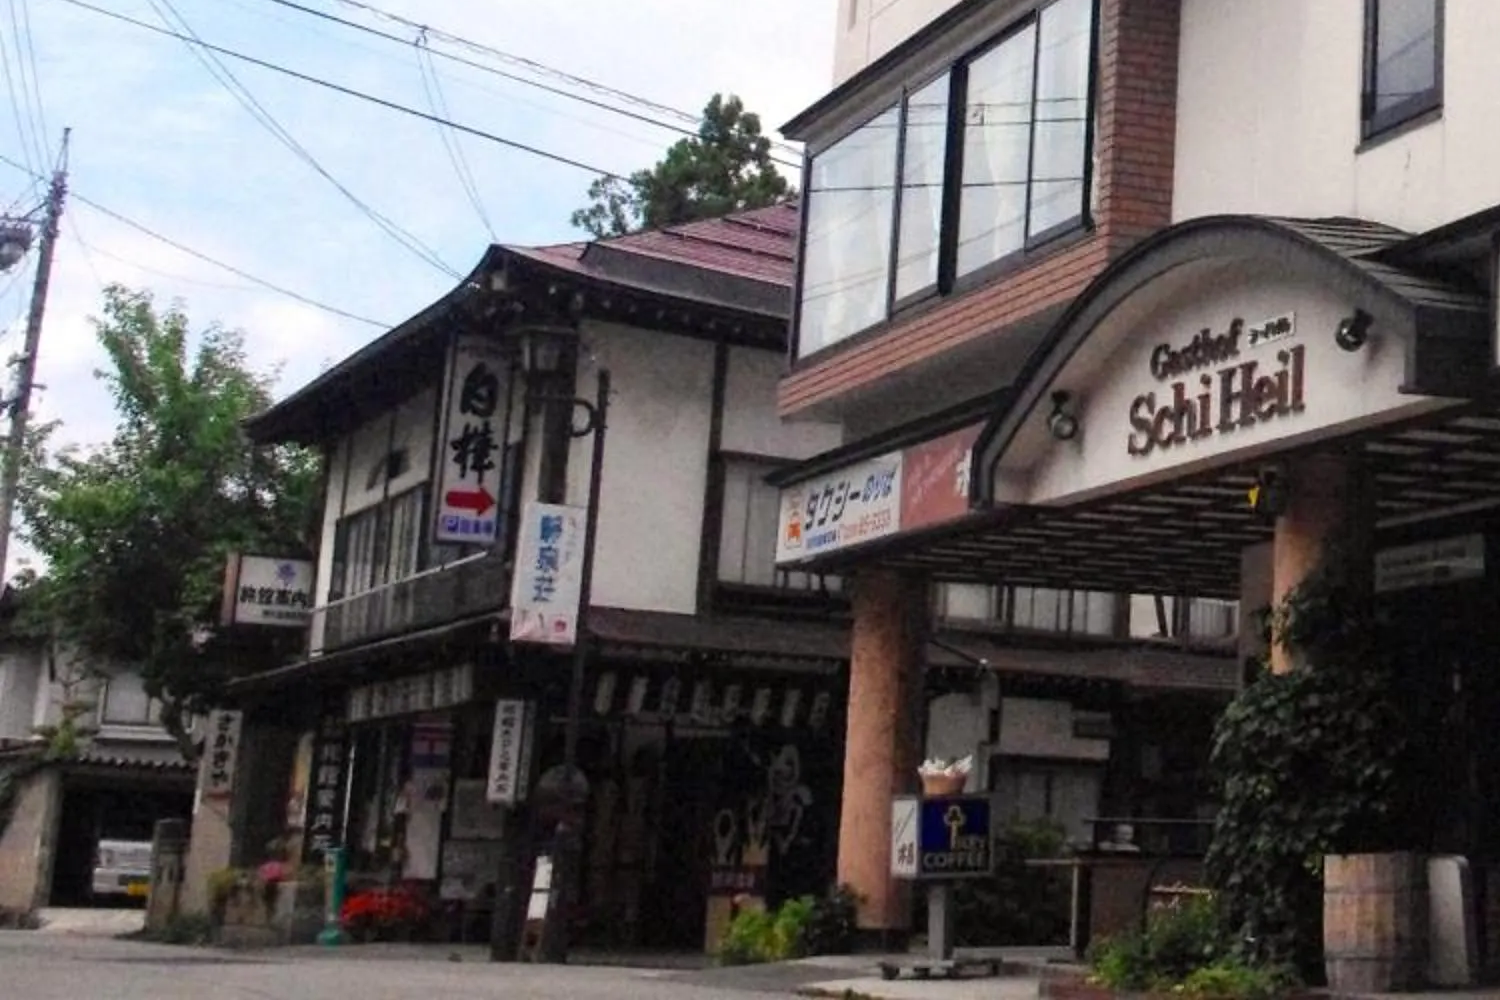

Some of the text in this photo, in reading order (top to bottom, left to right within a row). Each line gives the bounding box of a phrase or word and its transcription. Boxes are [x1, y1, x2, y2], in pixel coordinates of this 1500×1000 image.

[1150, 317, 1245, 381] Gasthof
[1127, 343, 1306, 456] Schi Heil
